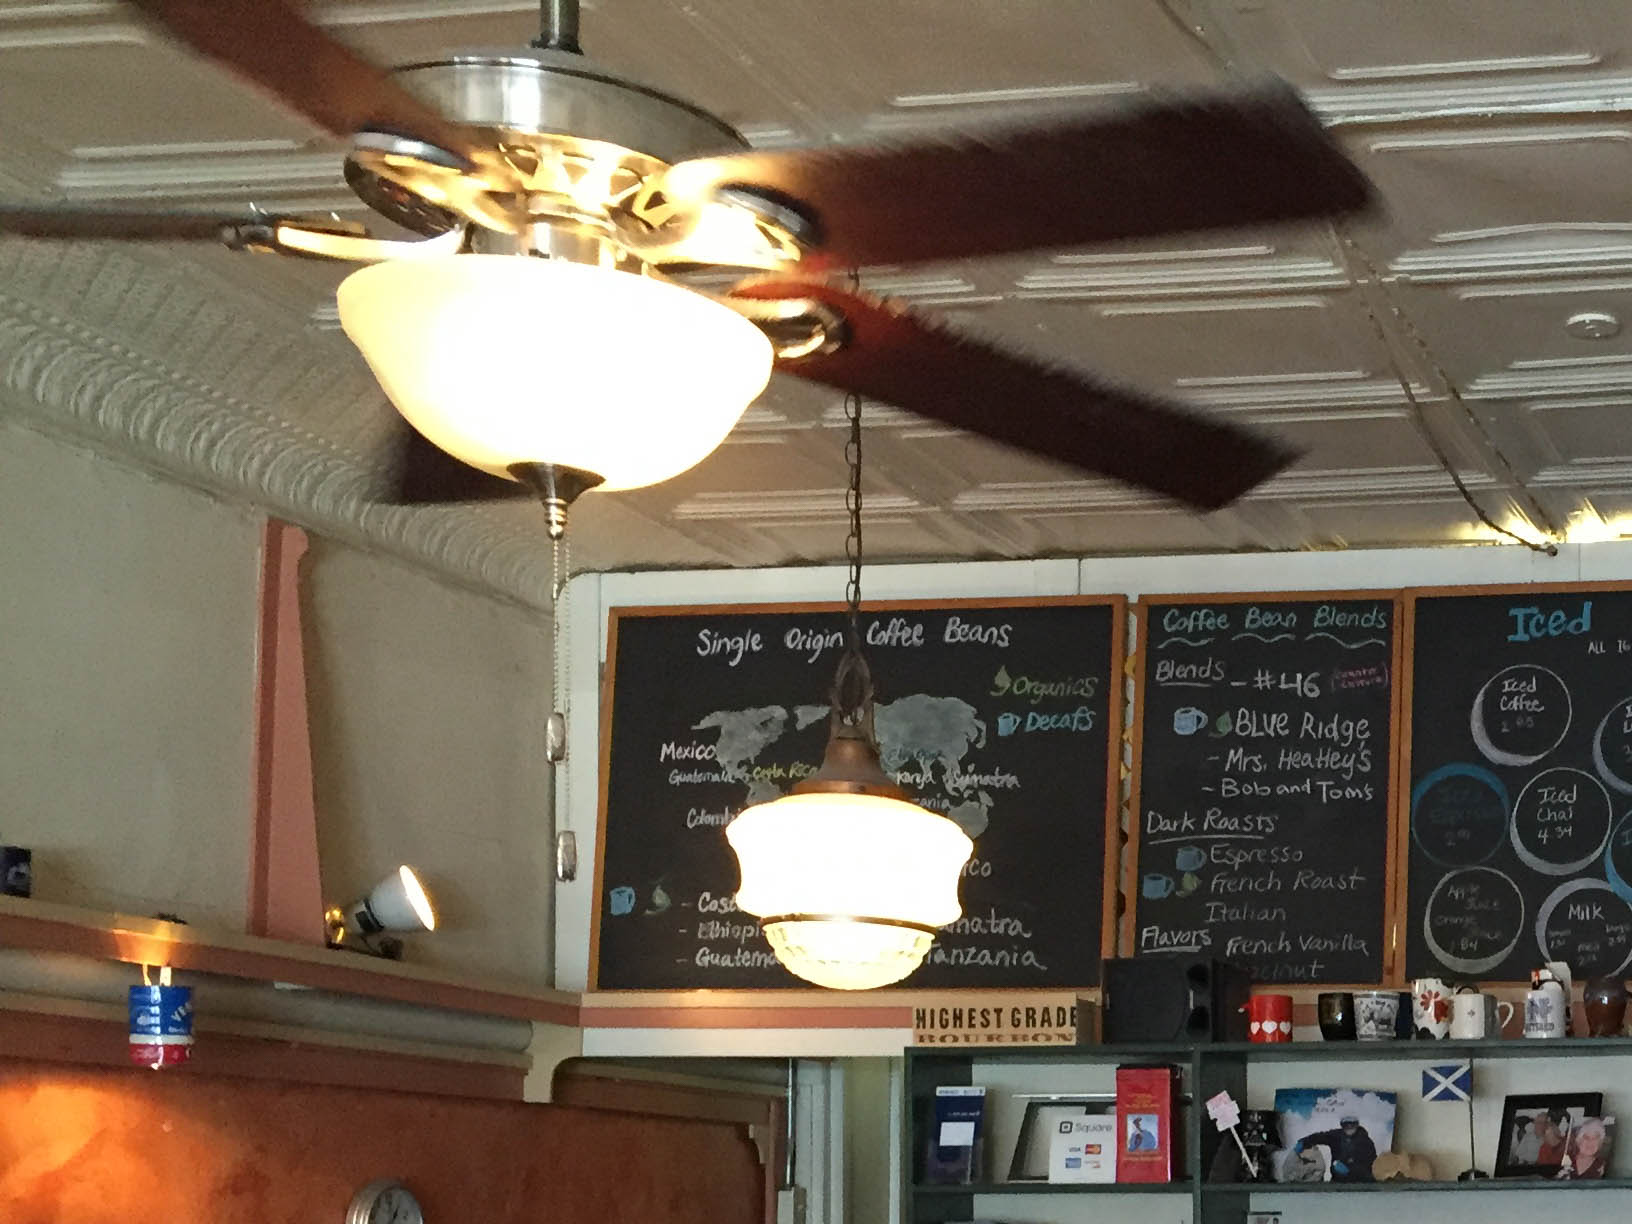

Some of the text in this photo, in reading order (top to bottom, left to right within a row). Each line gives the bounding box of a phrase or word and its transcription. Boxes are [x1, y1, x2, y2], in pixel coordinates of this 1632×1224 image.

[1163, 605, 1387, 632] Coffee Bean Blends
[1507, 600, 1593, 643] Iced
[697, 617, 1013, 666] Single Origin Coffee Beans
[1013, 676, 1098, 701] Organics
[1155, 657, 1321, 698] Blends #46
[1501, 675, 1537, 693] Iced
[1500, 696, 1545, 713] Coffee
[1027, 710, 1095, 733] Decafs
[661, 742, 717, 763] Mexico
[1223, 777, 1270, 797] Bob
[1276, 777, 1311, 795] and
[1537, 784, 1577, 805] Iced
[1146, 807, 1279, 834] Dark Roasts
[1210, 843, 1303, 871] Espresso
[1210, 865, 1367, 893] French Roast
[1205, 901, 1287, 923] Italian
[1141, 926, 1213, 948] Flavors
[1226, 932, 1292, 958] French
[915, 1005, 1077, 1029] HIGHEST GRADE
